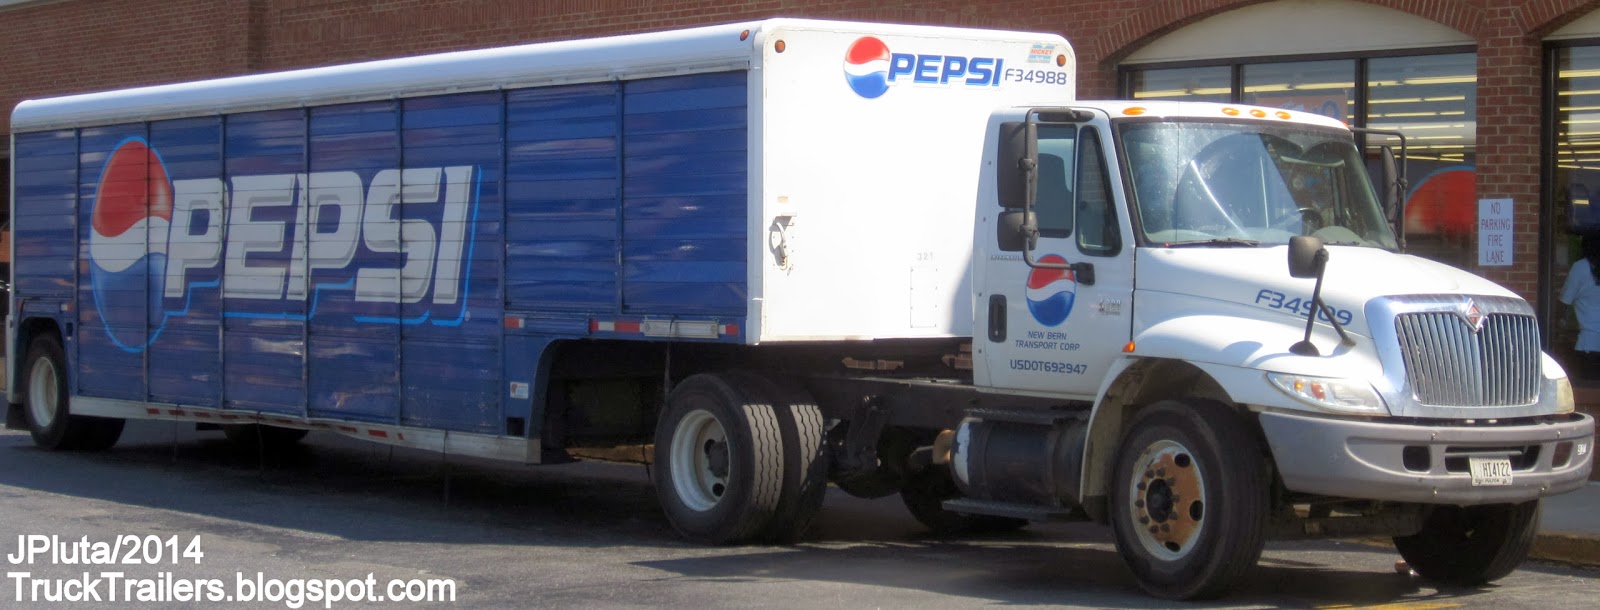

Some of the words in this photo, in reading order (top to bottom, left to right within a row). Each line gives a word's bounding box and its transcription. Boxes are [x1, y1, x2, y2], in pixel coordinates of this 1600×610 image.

[887, 52, 1004, 87] PEPSI
[1004, 67, 1068, 86] F34988
[1490, 202, 1501, 214] NO
[1481, 218, 1511, 230] PARKING
[164, 165, 474, 305] PEPSI
[1487, 234, 1503, 246] FIRE
[1486, 251, 1504, 263] LANE
[1027, 330, 1045, 340] NEW
[1047, 331, 1067, 341] BERN
[1015, 339, 1057, 351] TRANSPORT
[1010, 359, 1087, 375] USDOT692947
